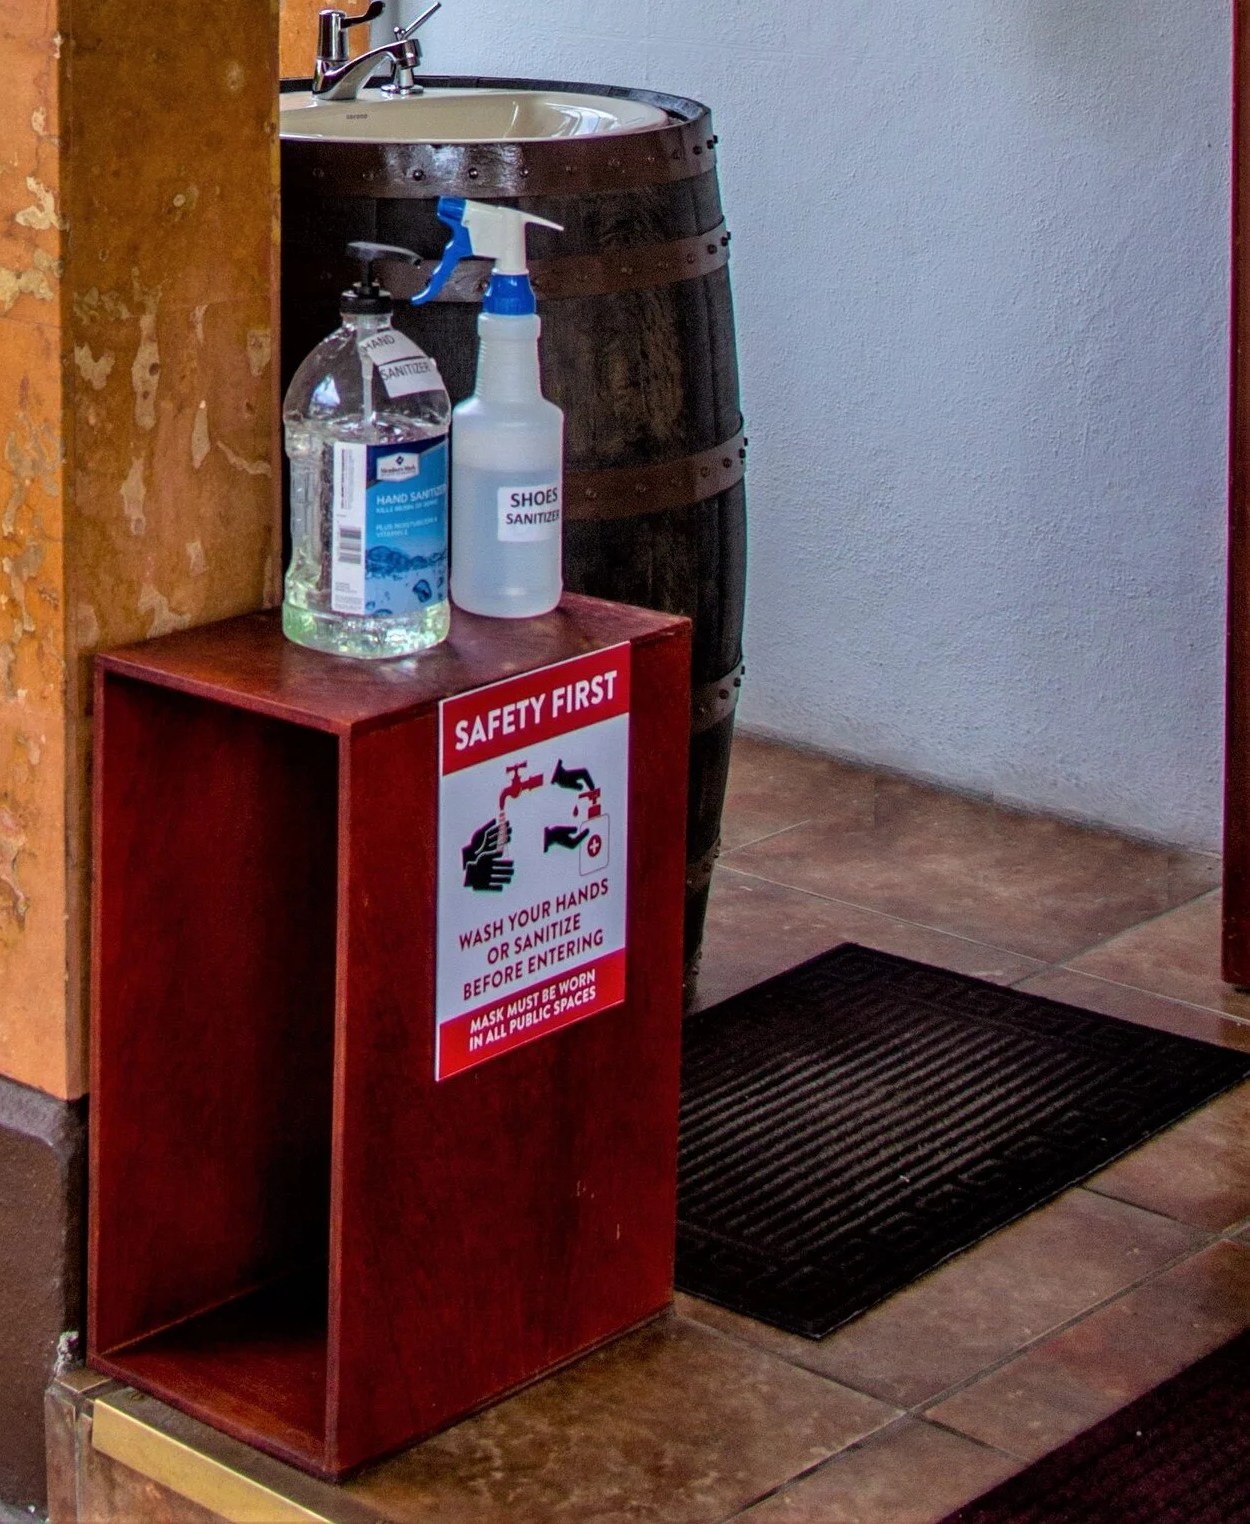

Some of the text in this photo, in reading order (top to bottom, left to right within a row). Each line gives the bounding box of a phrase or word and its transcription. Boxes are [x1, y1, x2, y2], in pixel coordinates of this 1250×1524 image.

[360, 335, 395, 354] HAND
[380, 362, 431, 381] SANITIZER
[376, 492, 408, 505] HAND
[510, 487, 558, 508] SHOES
[454, 670, 618, 751] SAFETY FIRST
[458, 878, 608, 952] WASH YOUR HANDS
[487, 913, 581, 964] OR SANITIZE
[463, 928, 604, 1001] BEFORE ENTERING
[469, 986, 596, 1052] IN ALL PUBLIC SPACES
[470, 968, 596, 1034] MASK MUST BE WORN
